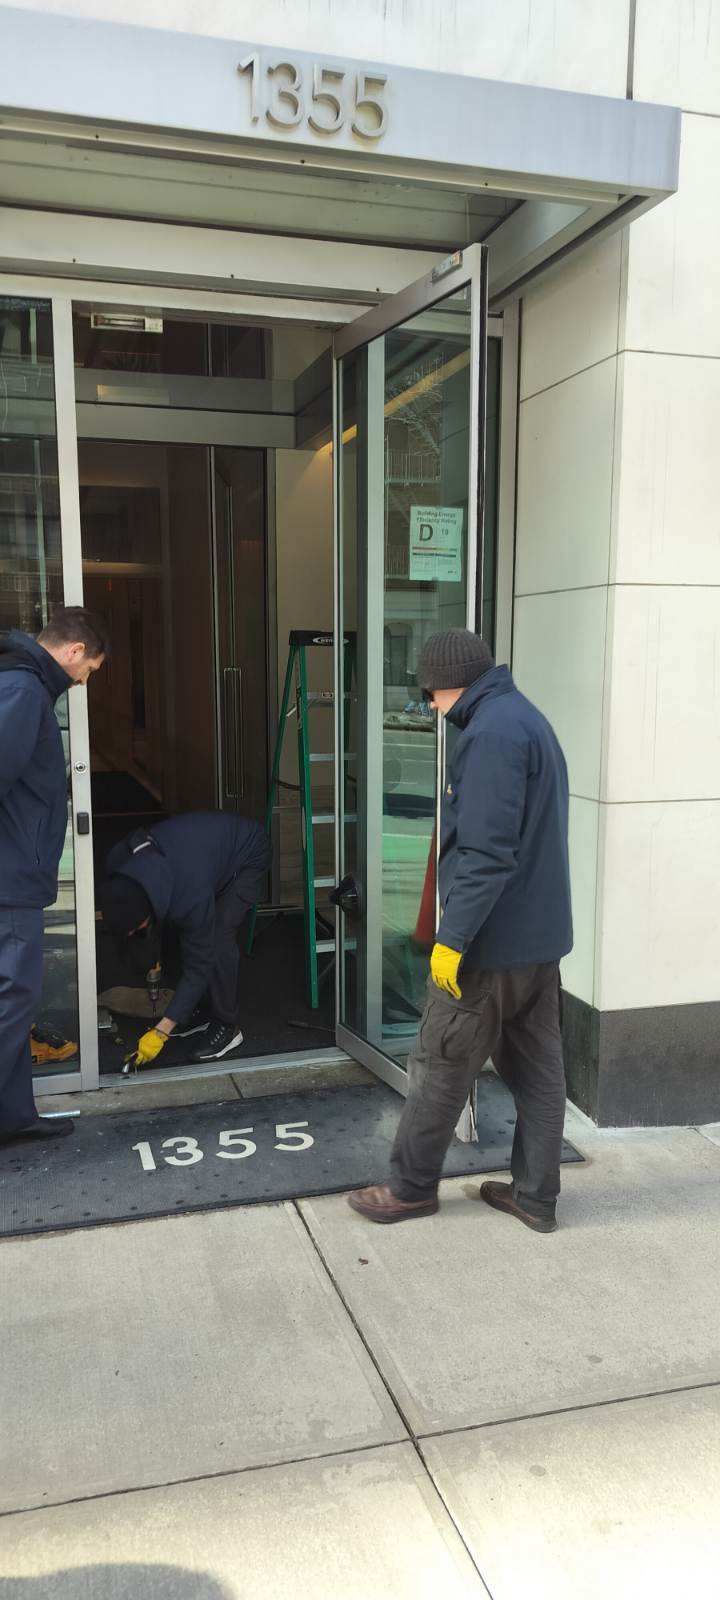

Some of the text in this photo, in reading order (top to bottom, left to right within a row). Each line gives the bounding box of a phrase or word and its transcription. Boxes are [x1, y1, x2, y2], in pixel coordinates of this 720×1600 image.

[237, 51, 388, 141] 1355
[419, 523, 434, 542] D
[131, 1121, 315, 1171] 1355
